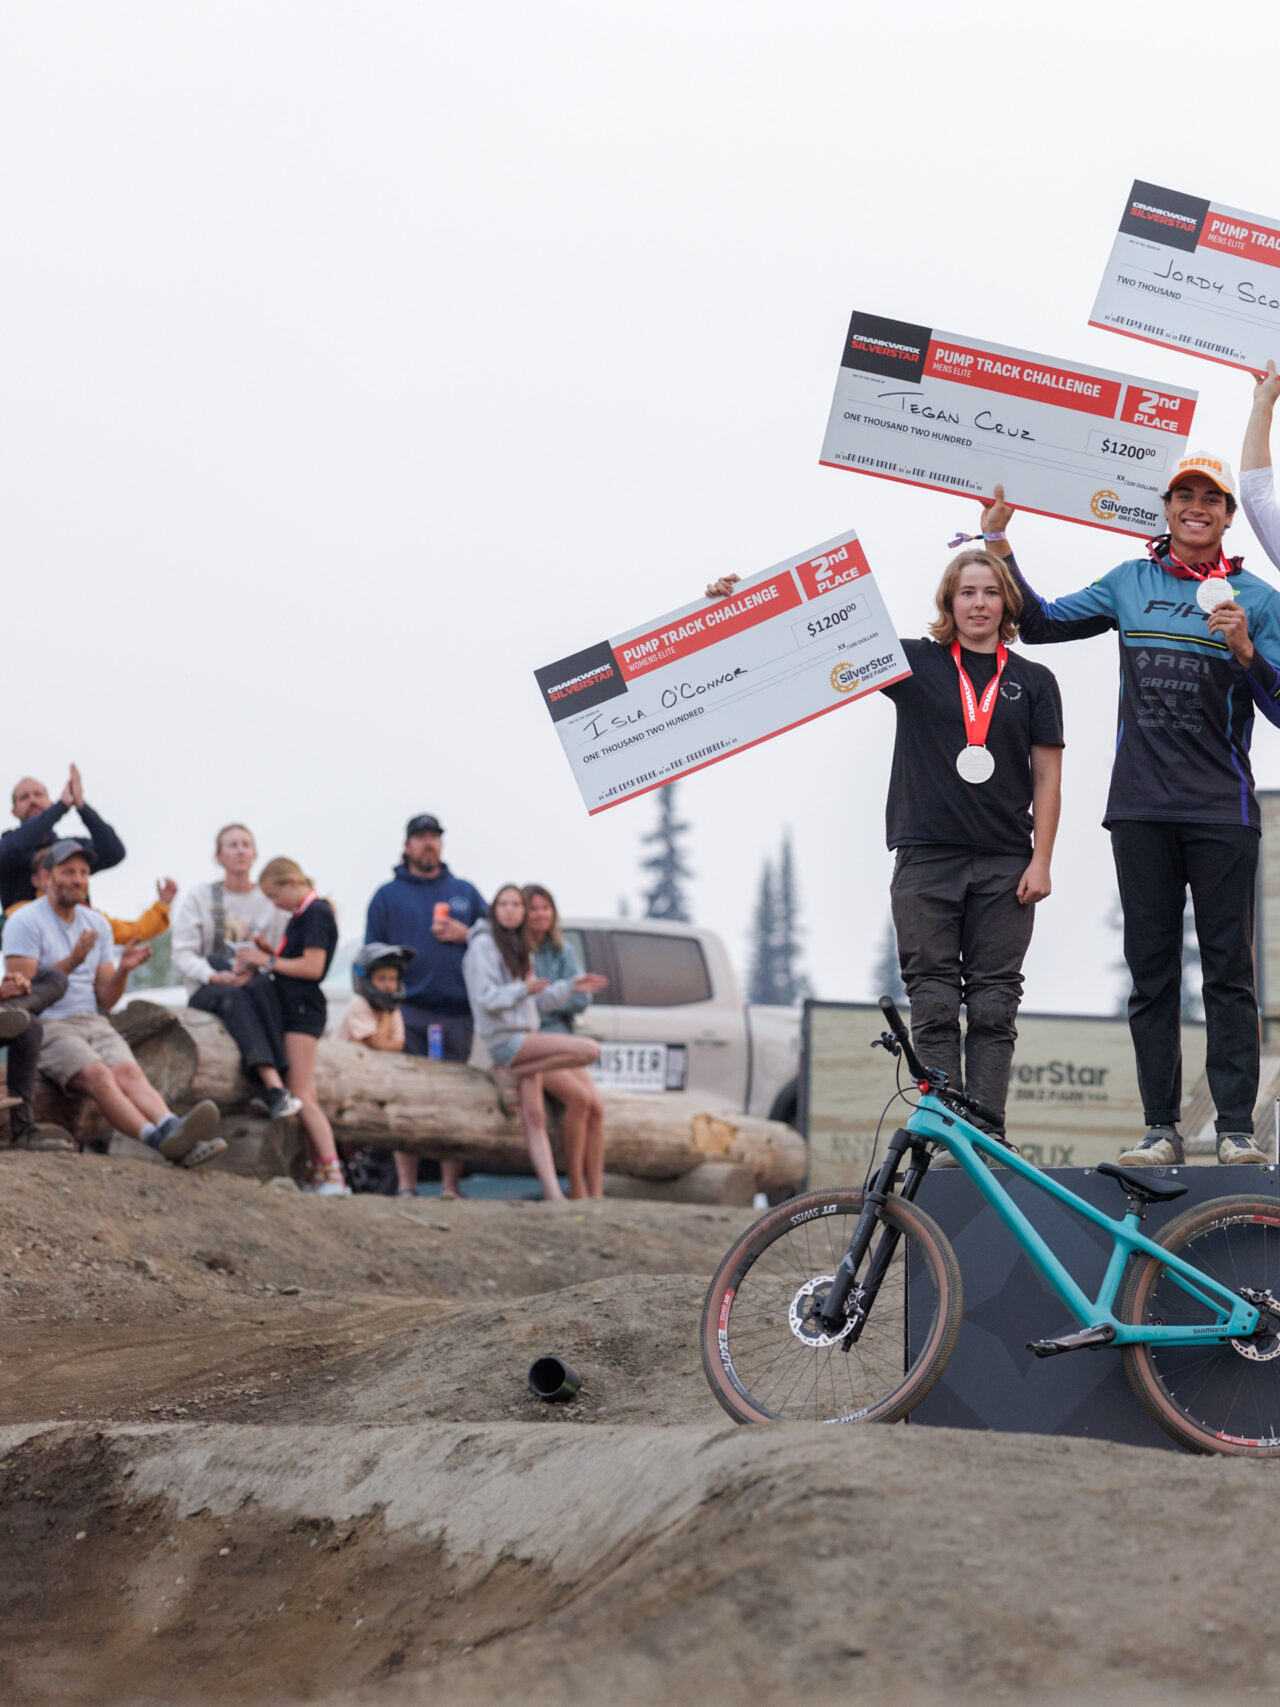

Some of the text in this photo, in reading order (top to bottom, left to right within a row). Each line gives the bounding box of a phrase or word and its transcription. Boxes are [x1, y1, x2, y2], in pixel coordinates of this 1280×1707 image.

[1129, 207, 1195, 232] SILVERSTAR
[1210, 220, 1249, 240] PUMP
[1207, 233, 1245, 250] MENS ELITE
[1116, 275, 1182, 300] TWO THOUSAND
[851, 340, 919, 362] SILVERSTAR
[932, 362, 971, 378] MENS ELITE
[934, 348, 1101, 397] PUMP TRACK CHALLENGE
[1137, 390, 1180, 417] 2nd
[843, 411, 972, 447] ONE THOUSAND TWO HUNDRED
[1133, 412, 1178, 431] PLACE
[1099, 498, 1159, 521] SilverStar
[809, 546, 850, 581] 2nd
[816, 566, 859, 593] PLACE
[622, 584, 779, 663] PUMP TRACK CHALLENGE
[627, 645, 675, 672] WOMENS ELITE
[838, 651, 894, 684] SilverStar
[1154, 653, 1210, 674] ARI
[549, 668, 614, 702] SILVERSTAR
[1139, 676, 1200, 693] SRAM
[582, 705, 704, 764] ONE THOUSAND TWO HUNDRED
[1008, 1059, 1109, 1086] verStar
[790, 1204, 838, 1225] DT SWISS
[1192, 1326, 1228, 1335] SHIMANO
